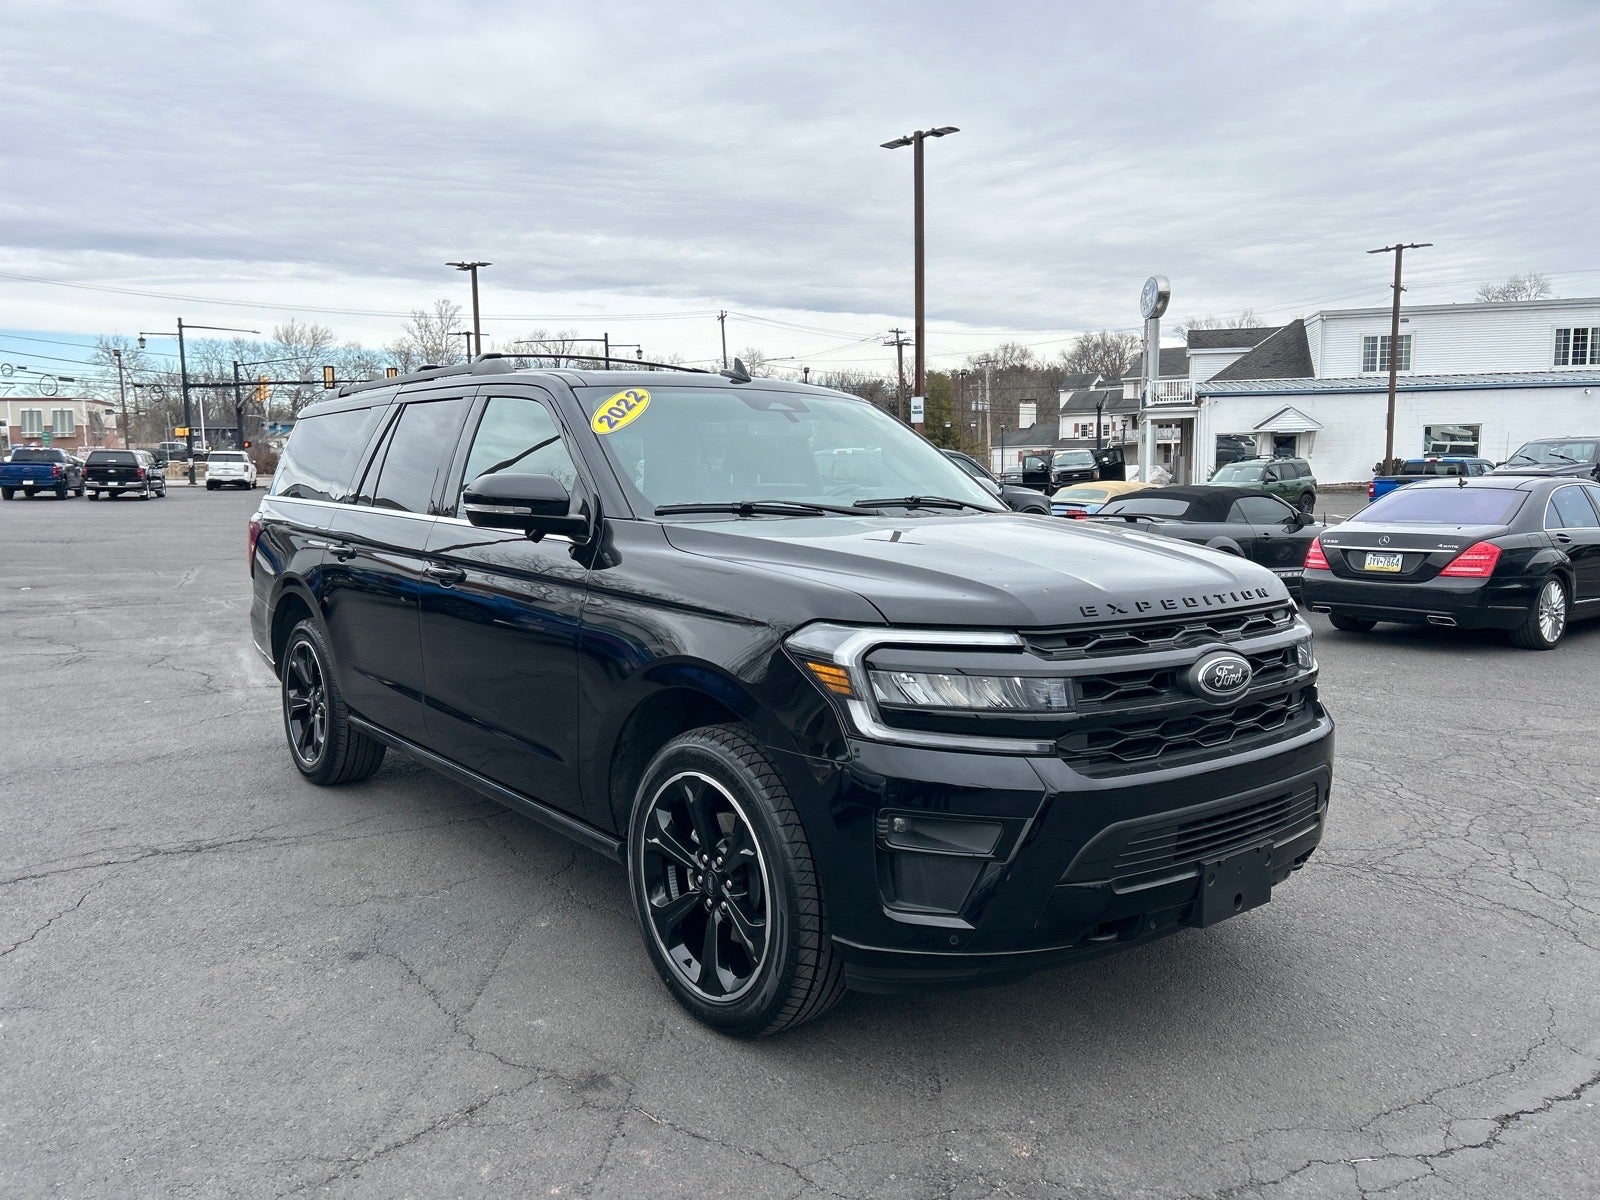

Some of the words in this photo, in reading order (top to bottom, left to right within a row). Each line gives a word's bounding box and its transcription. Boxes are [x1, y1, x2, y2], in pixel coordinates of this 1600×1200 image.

[598, 390, 646, 430] 2022
[1079, 587, 1270, 618] EXPEDITION
[1214, 664, 1243, 688] Ford
